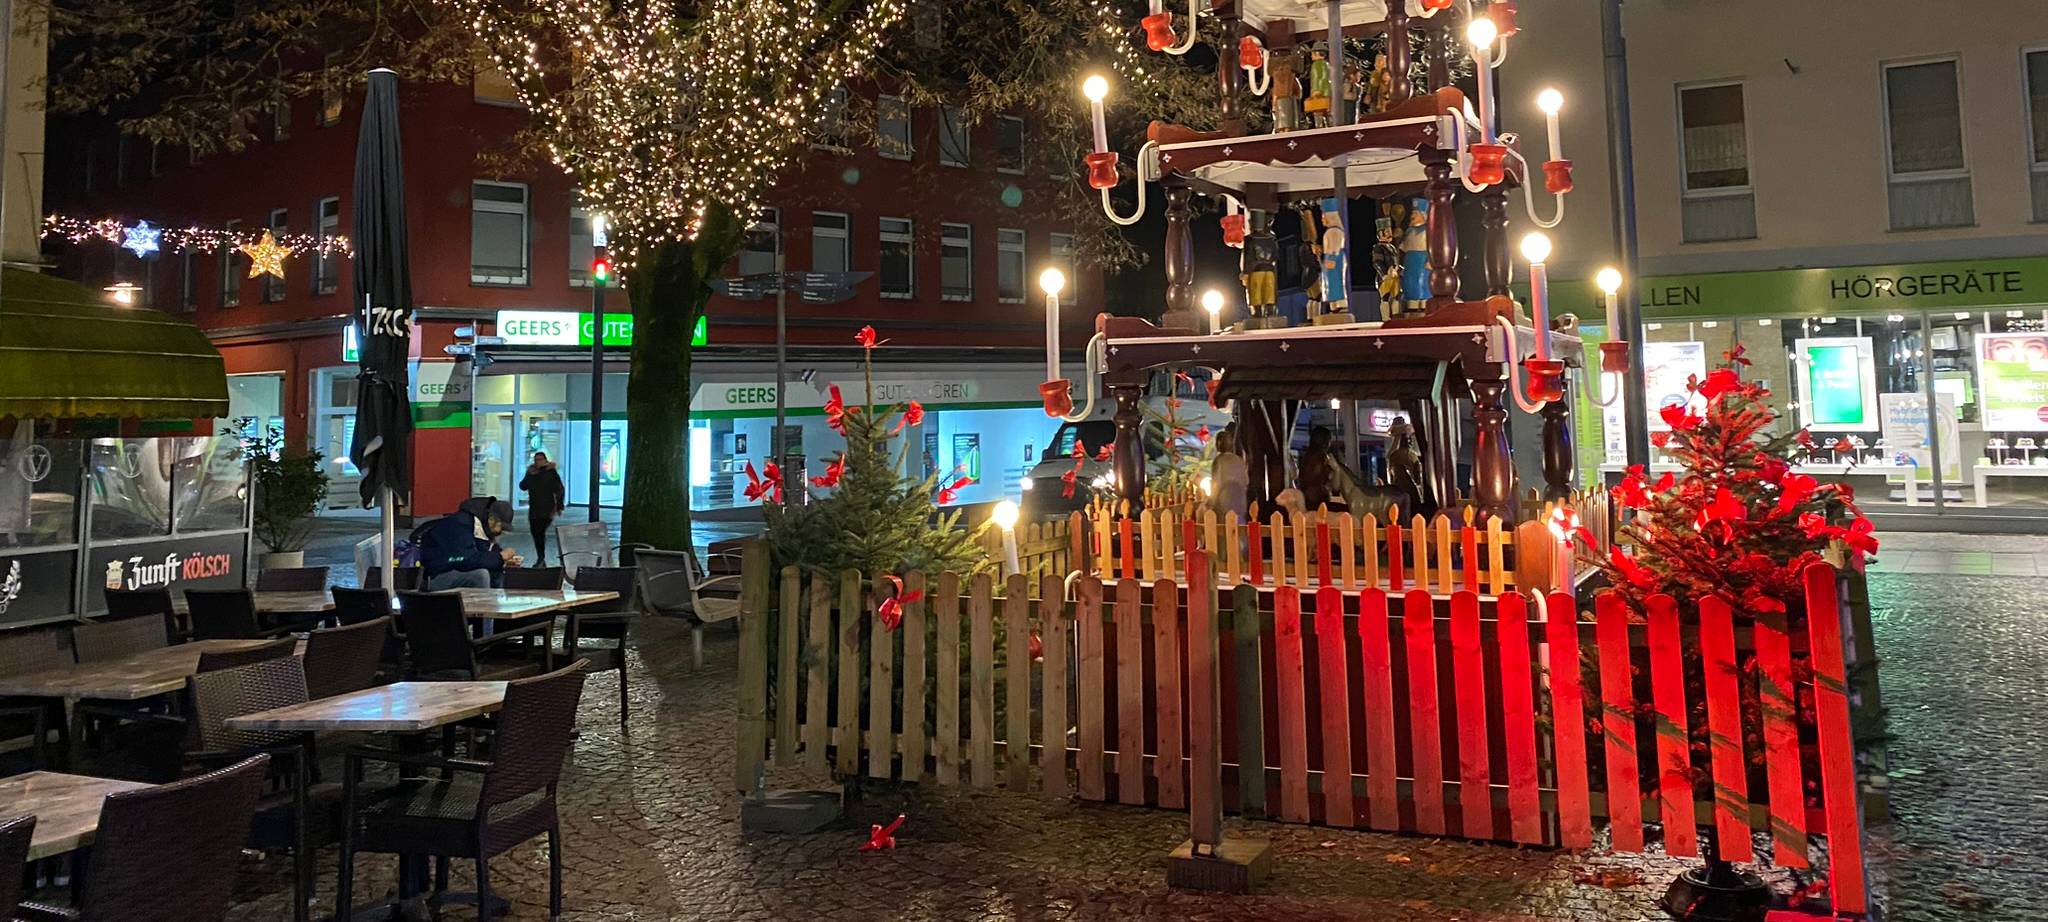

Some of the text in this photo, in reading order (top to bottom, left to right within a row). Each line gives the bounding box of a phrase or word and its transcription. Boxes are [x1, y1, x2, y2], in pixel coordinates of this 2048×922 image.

[1830, 269, 2024, 299] HÖRGERÄTE
[504, 319, 561, 337] GEERS
[419, 383, 461, 395] GEERS
[725, 386, 777, 404] GEERS
[127, 551, 231, 591] Zunft KÖLSCH
